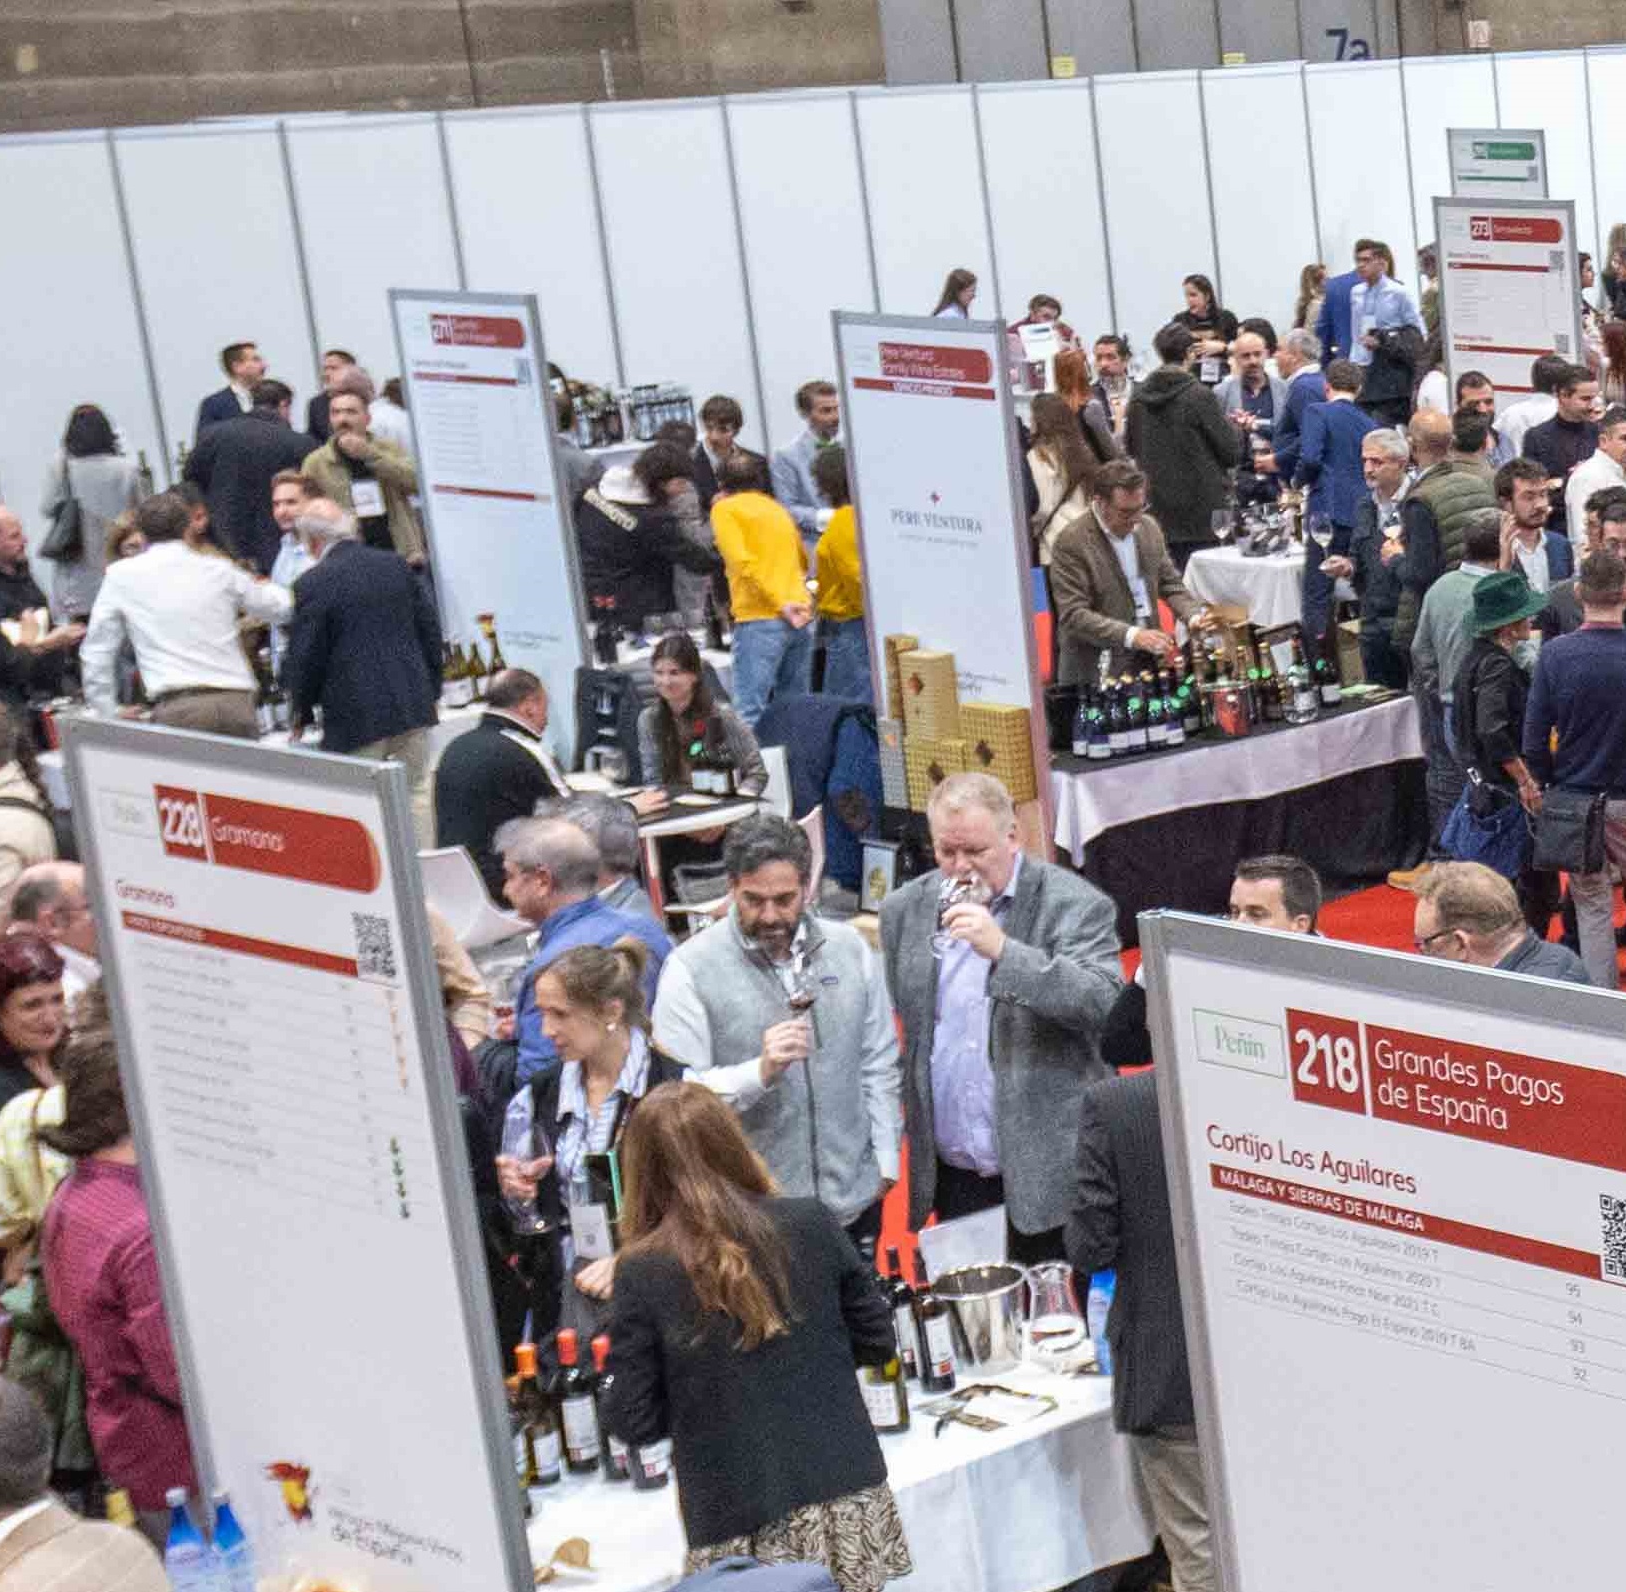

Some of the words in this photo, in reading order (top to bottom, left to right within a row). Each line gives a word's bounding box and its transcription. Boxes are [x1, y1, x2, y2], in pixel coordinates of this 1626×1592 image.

[924, 511, 983, 533] VENTURA
[158, 798, 205, 848] 228
[212, 816, 286, 852] Gramona
[1216, 1023, 1267, 1063] Peñin
[1294, 1027, 1360, 1093] 218
[1375, 1038, 1478, 1088] Grandes
[1486, 1063, 1565, 1107] Pagos
[1378, 1077, 1410, 1109] de
[1417, 1084, 1508, 1132] España
[1207, 1123, 1273, 1164] Cortijo
[1279, 1137, 1315, 1171] Los
[1320, 1151, 1418, 1195] Aguilares
[1219, 1168, 1277, 1196] MÁLAGA
[1277, 1184, 1285, 1197] Y
[1288, 1186, 1342, 1212] SIERRAS
[1345, 1199, 1364, 1217] DE
[1366, 1203, 1425, 1232] MÁLAGA
